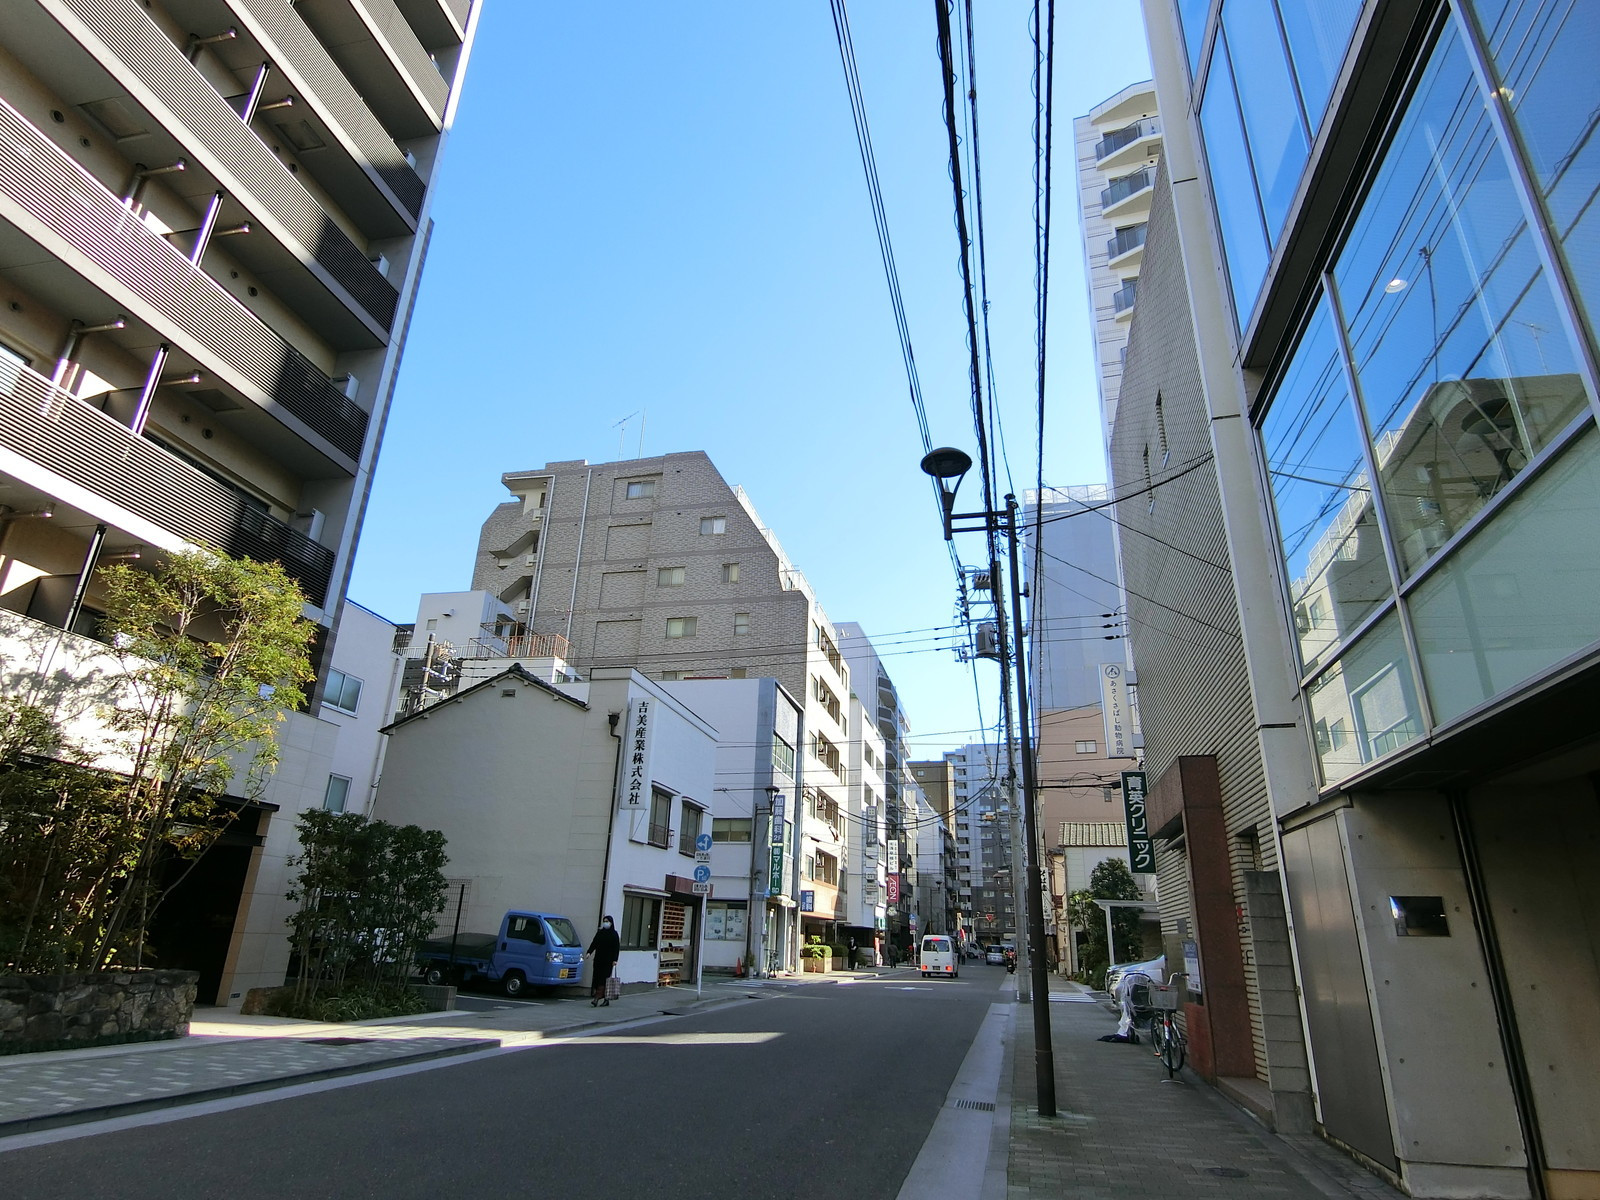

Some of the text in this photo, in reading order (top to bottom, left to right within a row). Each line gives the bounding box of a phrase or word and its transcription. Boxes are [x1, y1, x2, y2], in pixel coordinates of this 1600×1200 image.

[628, 701, 649, 805] 吉美産業株式会社
[1109, 680, 1124, 755] あさくさばし動物病院
